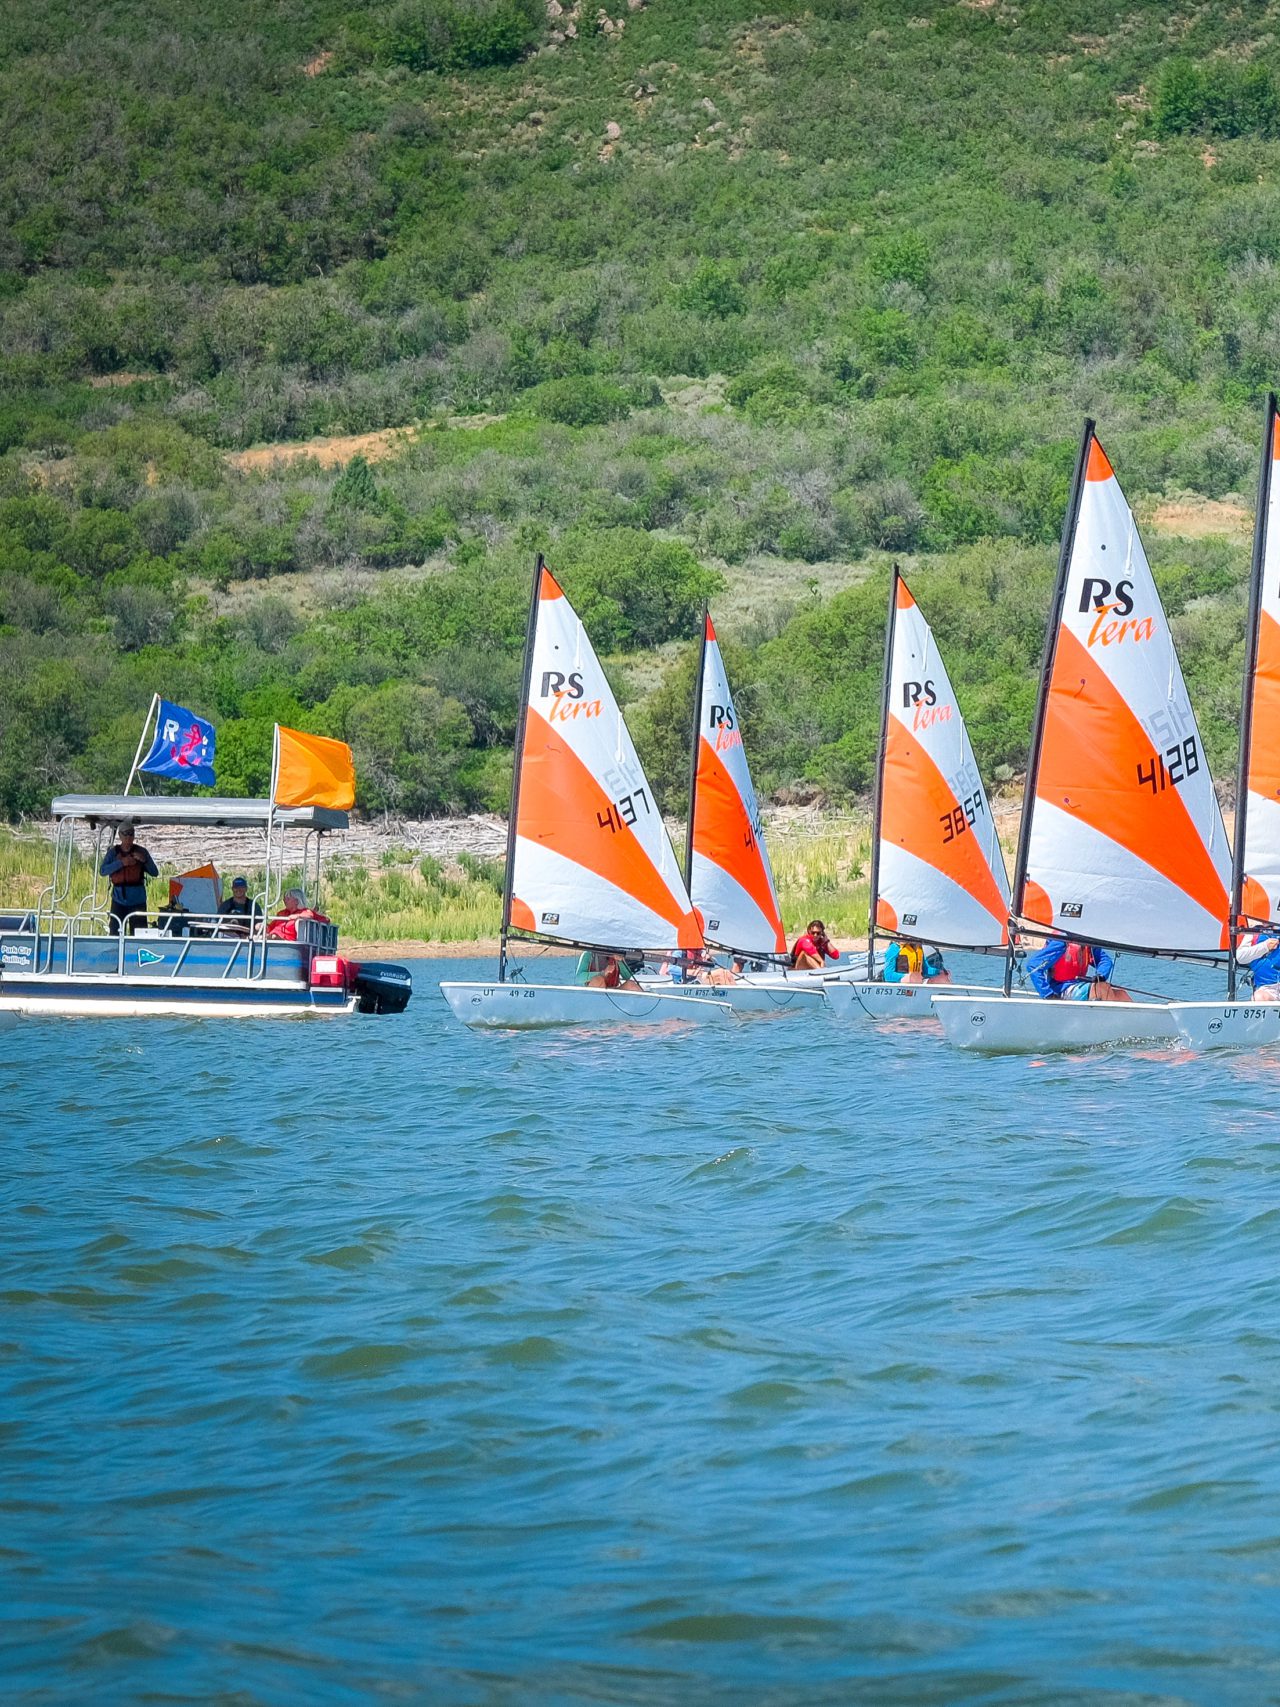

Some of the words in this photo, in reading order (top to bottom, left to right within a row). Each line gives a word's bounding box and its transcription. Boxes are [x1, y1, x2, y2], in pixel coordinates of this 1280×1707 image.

[1079, 578, 1134, 616] RS
[1087, 602, 1157, 648] Tera
[541, 671, 584, 699] RS
[903, 680, 936, 708] RS
[549, 689, 604, 722] Tera
[710, 705, 734, 730] RS
[913, 697, 952, 732] Tera
[1137, 735, 1199, 794] 4128
[597, 788, 650, 833] 4137
[940, 789, 984, 844] 3859
[544, 913, 558, 921] RS
[904, 914, 917, 922] RS
[1063, 903, 1081, 912] RS
[483, 989, 495, 997] UT
[523, 990, 535, 998] ZB
[1224, 1009, 1238, 1019] UT
[1243, 1009, 1266, 1019] 8751
